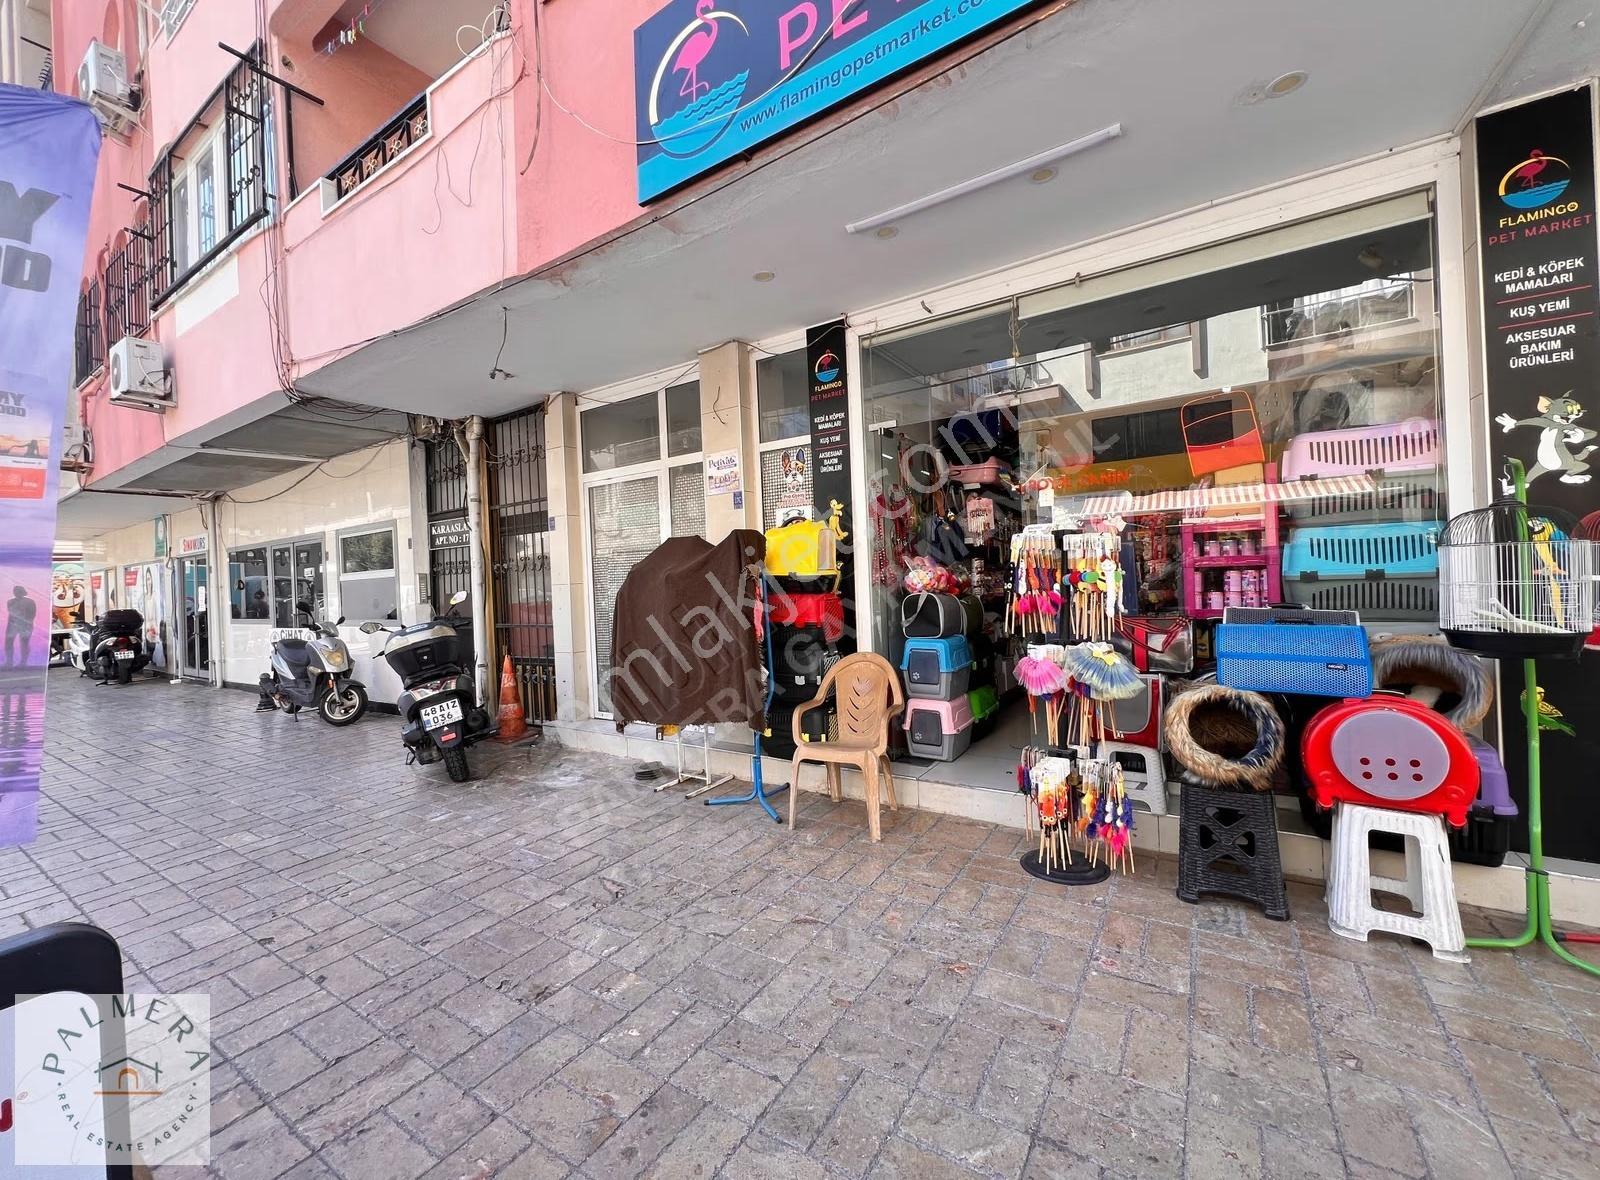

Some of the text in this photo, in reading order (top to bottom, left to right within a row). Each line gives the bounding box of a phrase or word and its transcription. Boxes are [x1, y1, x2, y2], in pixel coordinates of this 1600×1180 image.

[779, 0, 899, 70] PE
[1499, 201, 1579, 229] FLAMINGO
[1488, 214, 1593, 246] PET MARKET
[1494, 256, 1585, 283] KEDİ & KÖPEK
[1505, 272, 1574, 294] MAMALARI
[1510, 296, 1571, 318] KUŞ YEMİ
[1505, 324, 1577, 345] AKSESUAR
[1520, 339, 1562, 355] BAKIM
[1509, 347, 1575, 369] ÜRÜNLERİ
[814, 380, 842, 393] FLAMINGO
[823, 388, 845, 400] MARKET
[431, 521, 471, 536] KARAASLA
[424, 706, 437, 717] 48
[432, 711, 453, 725] 036
